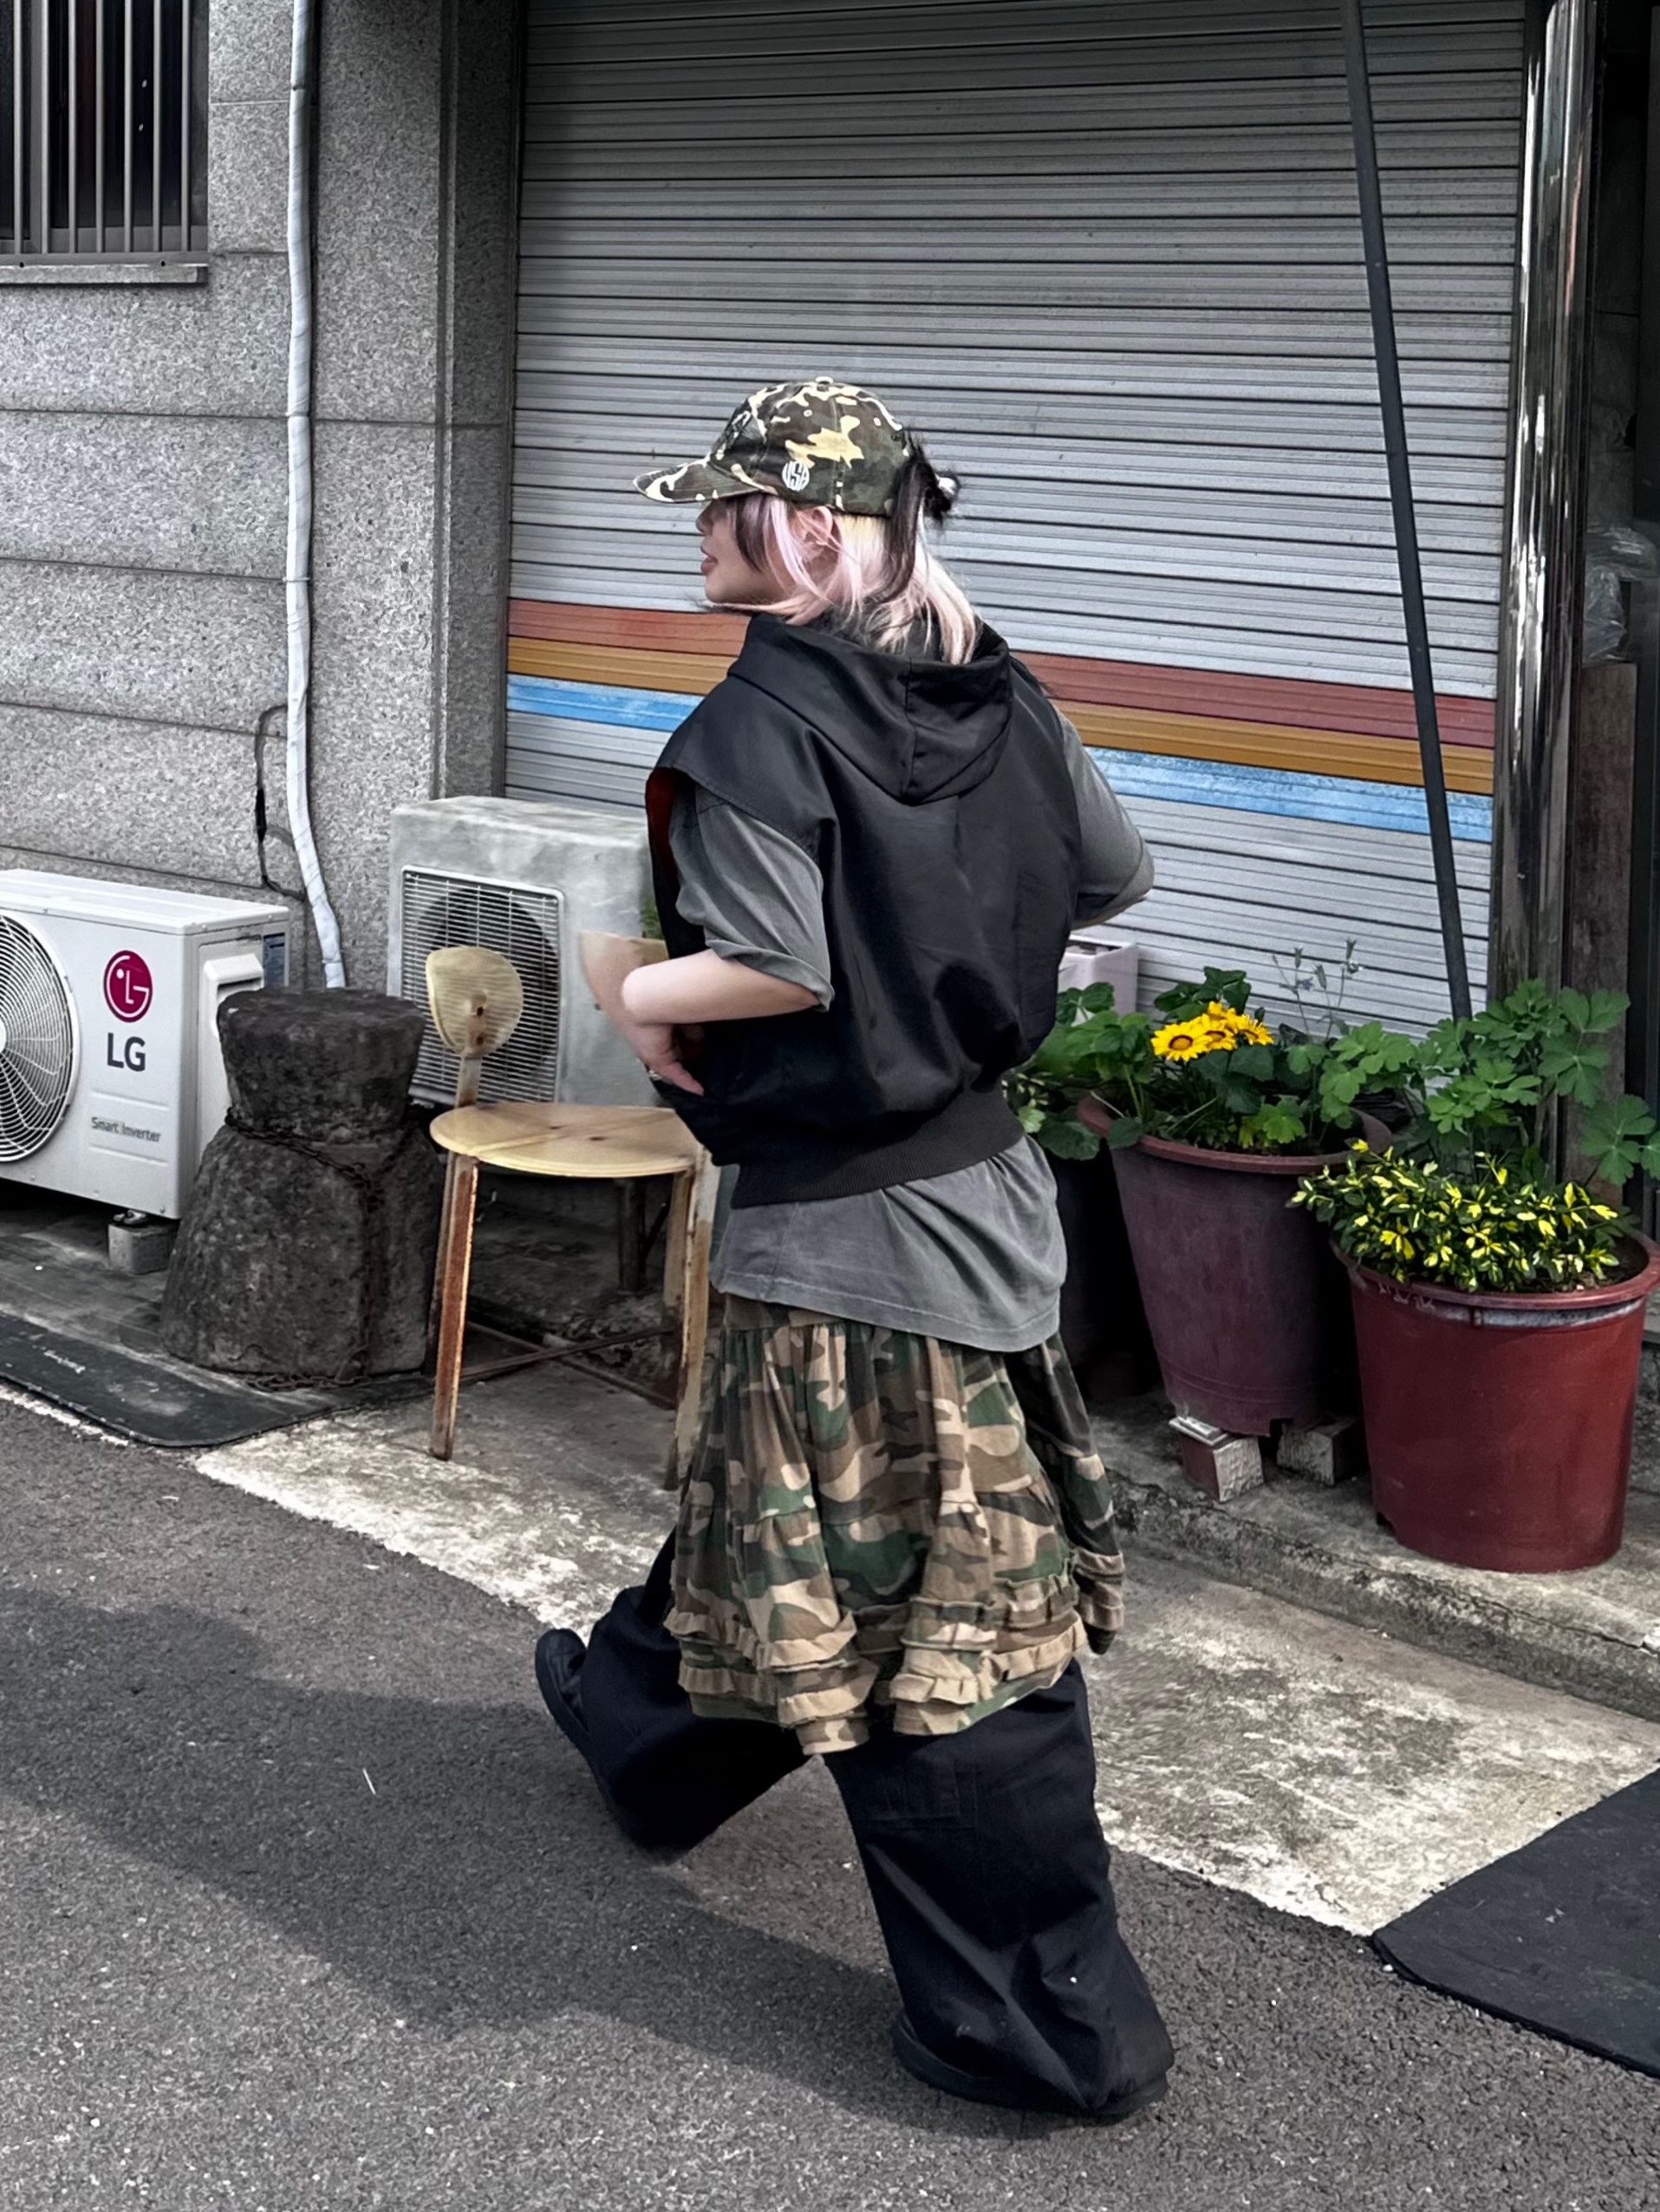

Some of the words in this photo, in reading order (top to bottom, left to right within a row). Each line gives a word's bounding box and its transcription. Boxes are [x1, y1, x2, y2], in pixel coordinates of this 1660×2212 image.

[105, 953, 151, 1020] LG
[107, 1032, 146, 1071] LG
[91, 1116, 120, 1134] Smart
[121, 1122, 160, 1142] Inverter
